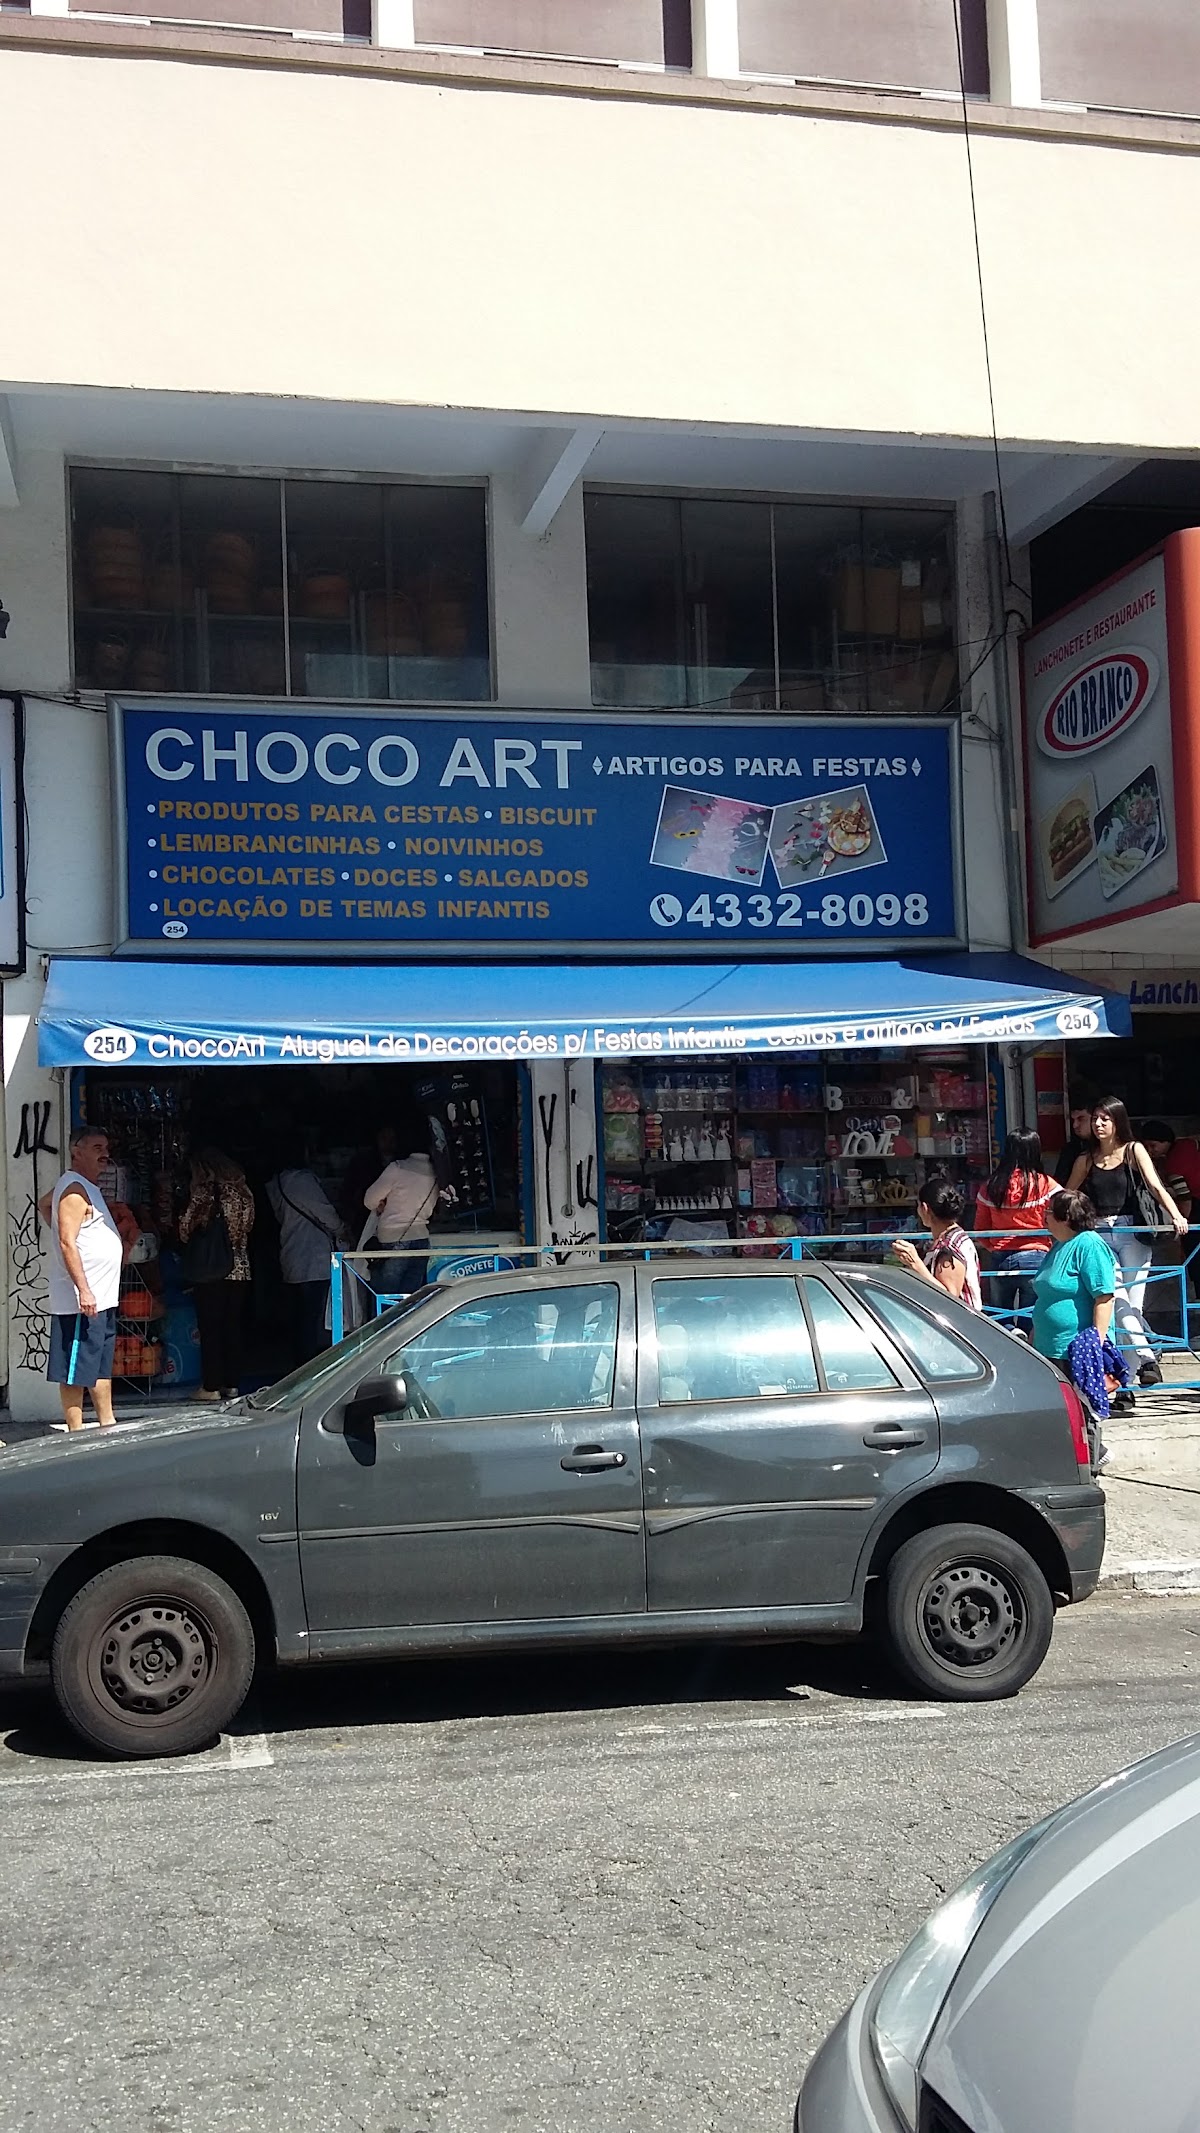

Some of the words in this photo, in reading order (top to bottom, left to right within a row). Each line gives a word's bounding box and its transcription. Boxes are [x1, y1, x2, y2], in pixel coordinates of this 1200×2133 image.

[1034, 633, 1085, 677] LANCHONETE
[1086, 629, 1092, 646] E
[1094, 589, 1156, 641] RESTAURANTE
[1057, 689, 1078, 739] RIO
[1081, 665, 1133, 738] BRANCO
[145, 728, 419, 787] CHOCO
[439, 737, 583, 790] ART
[607, 756, 724, 777] ARTIGOS
[735, 757, 802, 777] PARA
[812, 758, 907, 778] FESTAS
[159, 800, 299, 821] PRODUTOS
[310, 804, 376, 823] PARA
[384, 805, 479, 824] CESTAS
[500, 807, 597, 826] BISCUIT
[160, 833, 380, 855] LEMBRANCINHAS
[404, 837, 543, 857] NOIVINHOS
[162, 865, 335, 886] CHOCOLATES
[354, 868, 437, 887] DOCES
[458, 869, 588, 889] SALGADOS
[163, 895, 287, 922] LOCAÇÃO
[300, 899, 332, 918] DE
[341, 899, 426, 919] TEMAS
[438, 900, 549, 919] INFANTIS
[686, 892, 929, 928] 4332-8098
[166, 925, 185, 935] 254
[1130, 979, 1199, 1004] Lanch
[1064, 1013, 1092, 1030] 254
[93, 1036, 127, 1054] 254
[148, 1034, 265, 1058] ChocoArt
[280, 1034, 371, 1062] Aluguel
[377, 1035, 410, 1056] de
[414, 1031, 557, 1059] Decorações
[564, 1029, 587, 1056] p/
[595, 1027, 662, 1051] Festas
[668, 1025, 746, 1049] Infantis
[842, 1026, 857, 1042] e
[822, 1085, 844, 1111] B
[449, 1259, 494, 1279] SORVETE
[260, 1512, 280, 1521] 16V
